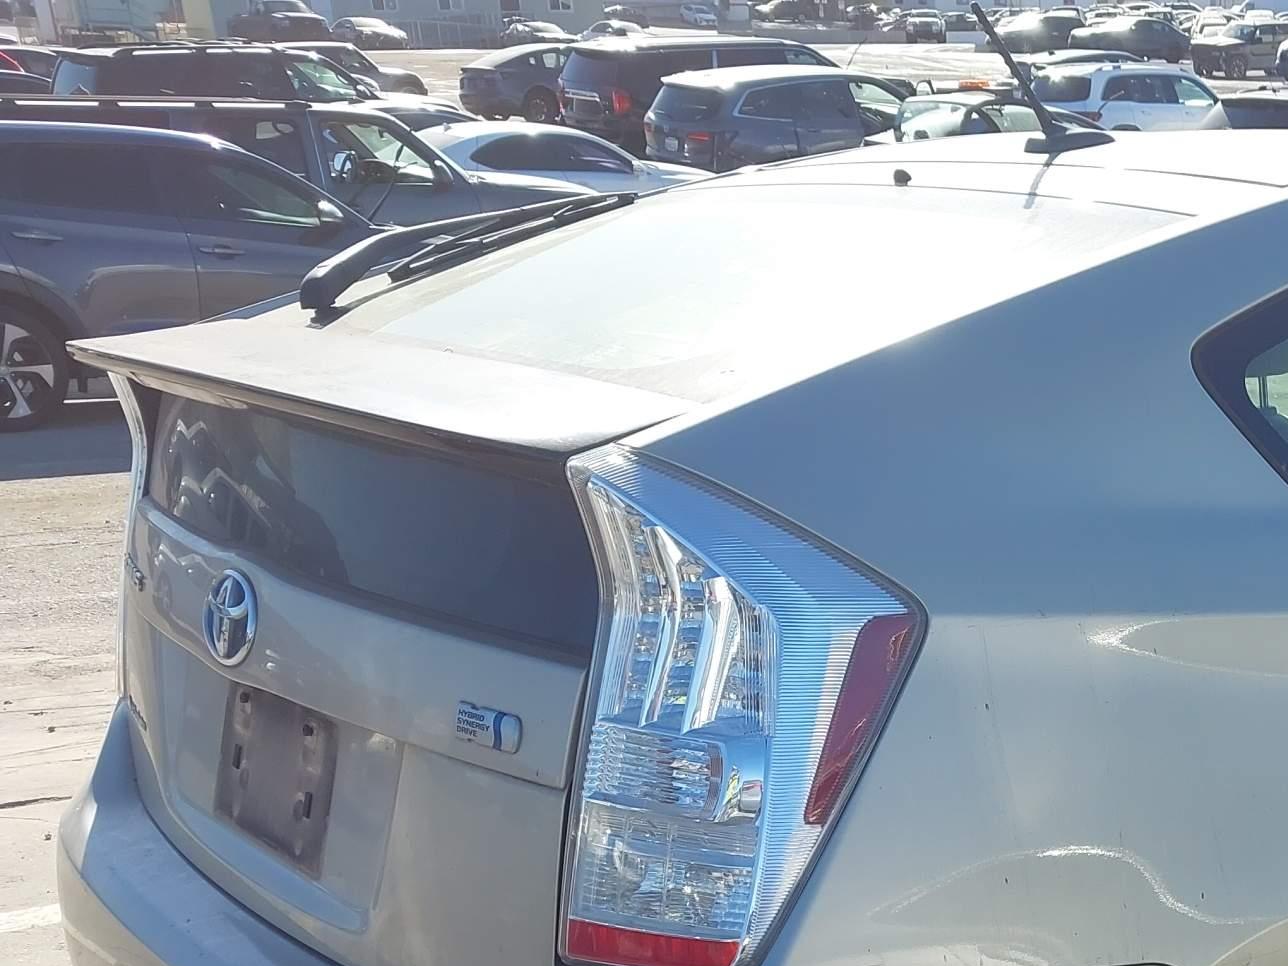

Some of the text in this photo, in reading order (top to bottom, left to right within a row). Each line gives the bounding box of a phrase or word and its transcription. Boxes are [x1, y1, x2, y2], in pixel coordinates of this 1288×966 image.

[457, 709, 485, 722] HYBRID
[456, 717, 491, 732] SYNERGY
[456, 725, 478, 738] DRIVE
